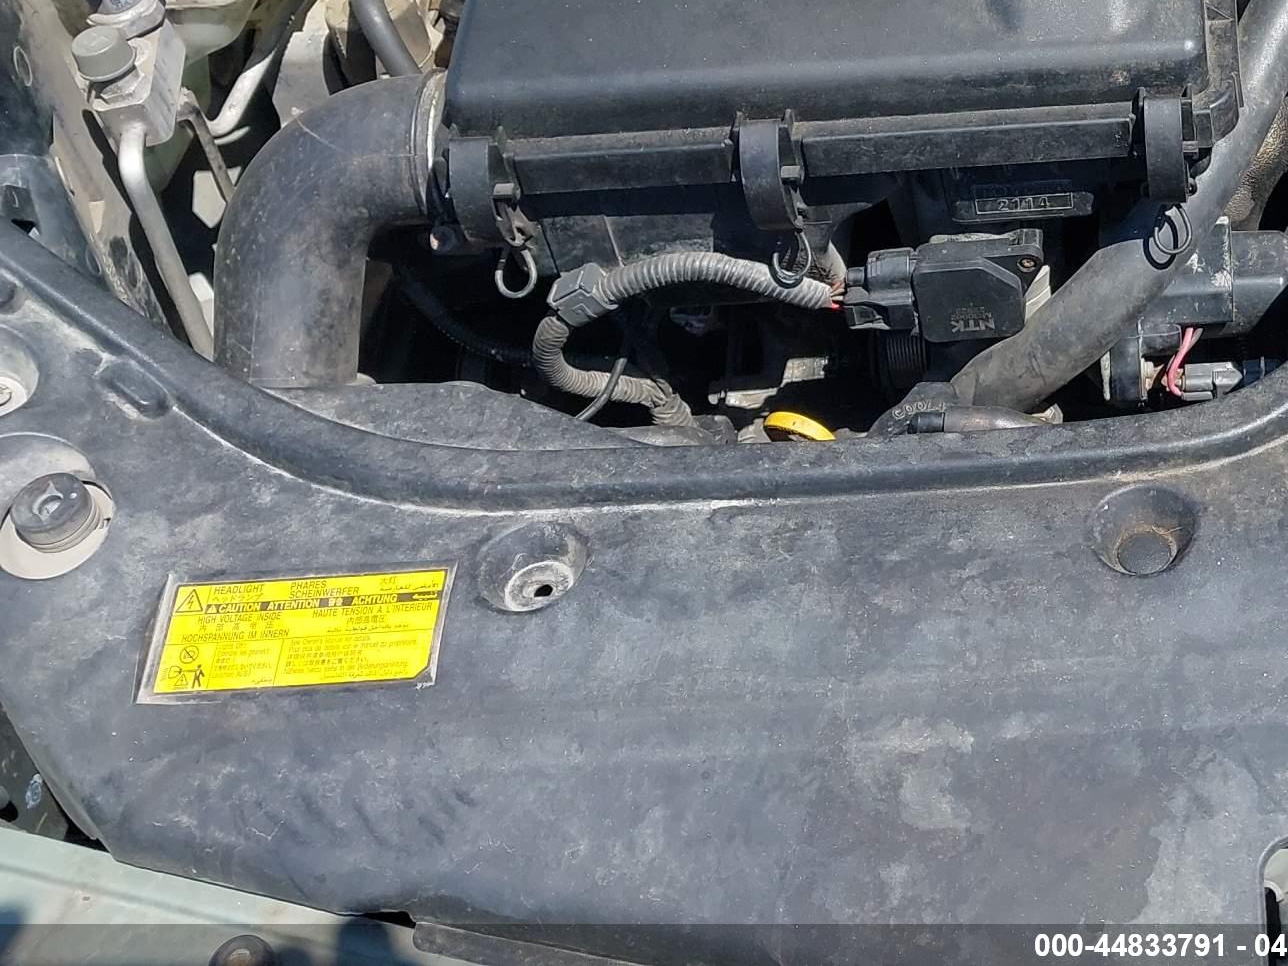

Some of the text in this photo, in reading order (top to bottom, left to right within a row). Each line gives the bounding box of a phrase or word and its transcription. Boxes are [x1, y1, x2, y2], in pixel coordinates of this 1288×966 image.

[951, 319, 995, 334] NTK
[214, 580, 327, 595] HEADLIGHT PHARES
[290, 587, 359, 599] SCHEINWERFER
[219, 594, 398, 613] CAUTION ATTENTION ACHTUNG
[198, 612, 281, 624] HIGH VOLTAGE INSIDE
[312, 609, 337, 618] HAUTE
[341, 606, 373, 616] TENSION
[182, 631, 245, 642] HOCHSPANNUNG
[260, 629, 290, 637] INNERN
